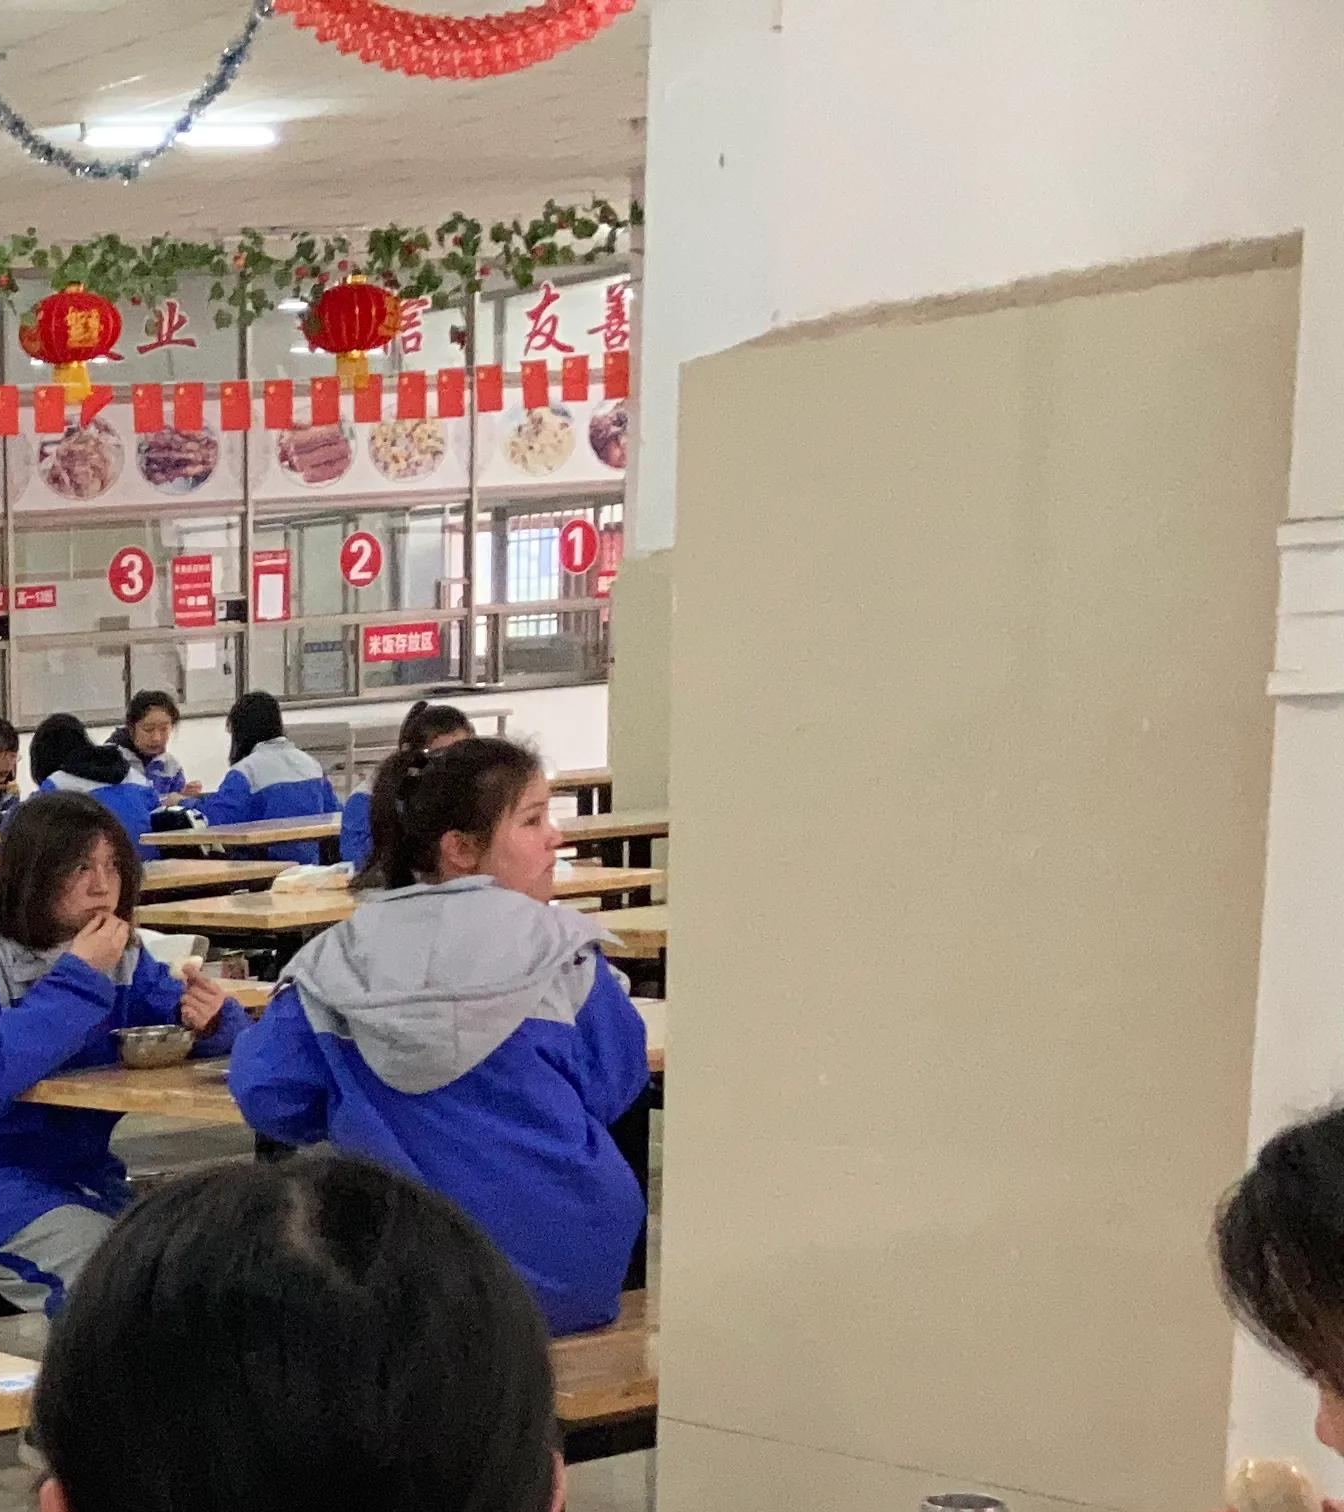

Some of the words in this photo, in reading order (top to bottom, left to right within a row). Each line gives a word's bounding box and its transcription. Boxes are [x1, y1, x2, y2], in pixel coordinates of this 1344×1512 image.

[349, 538, 373, 581] 2
[567, 527, 584, 567] 1
[120, 553, 145, 596] 3
[368, 630, 436, 657] 米饭存放区
